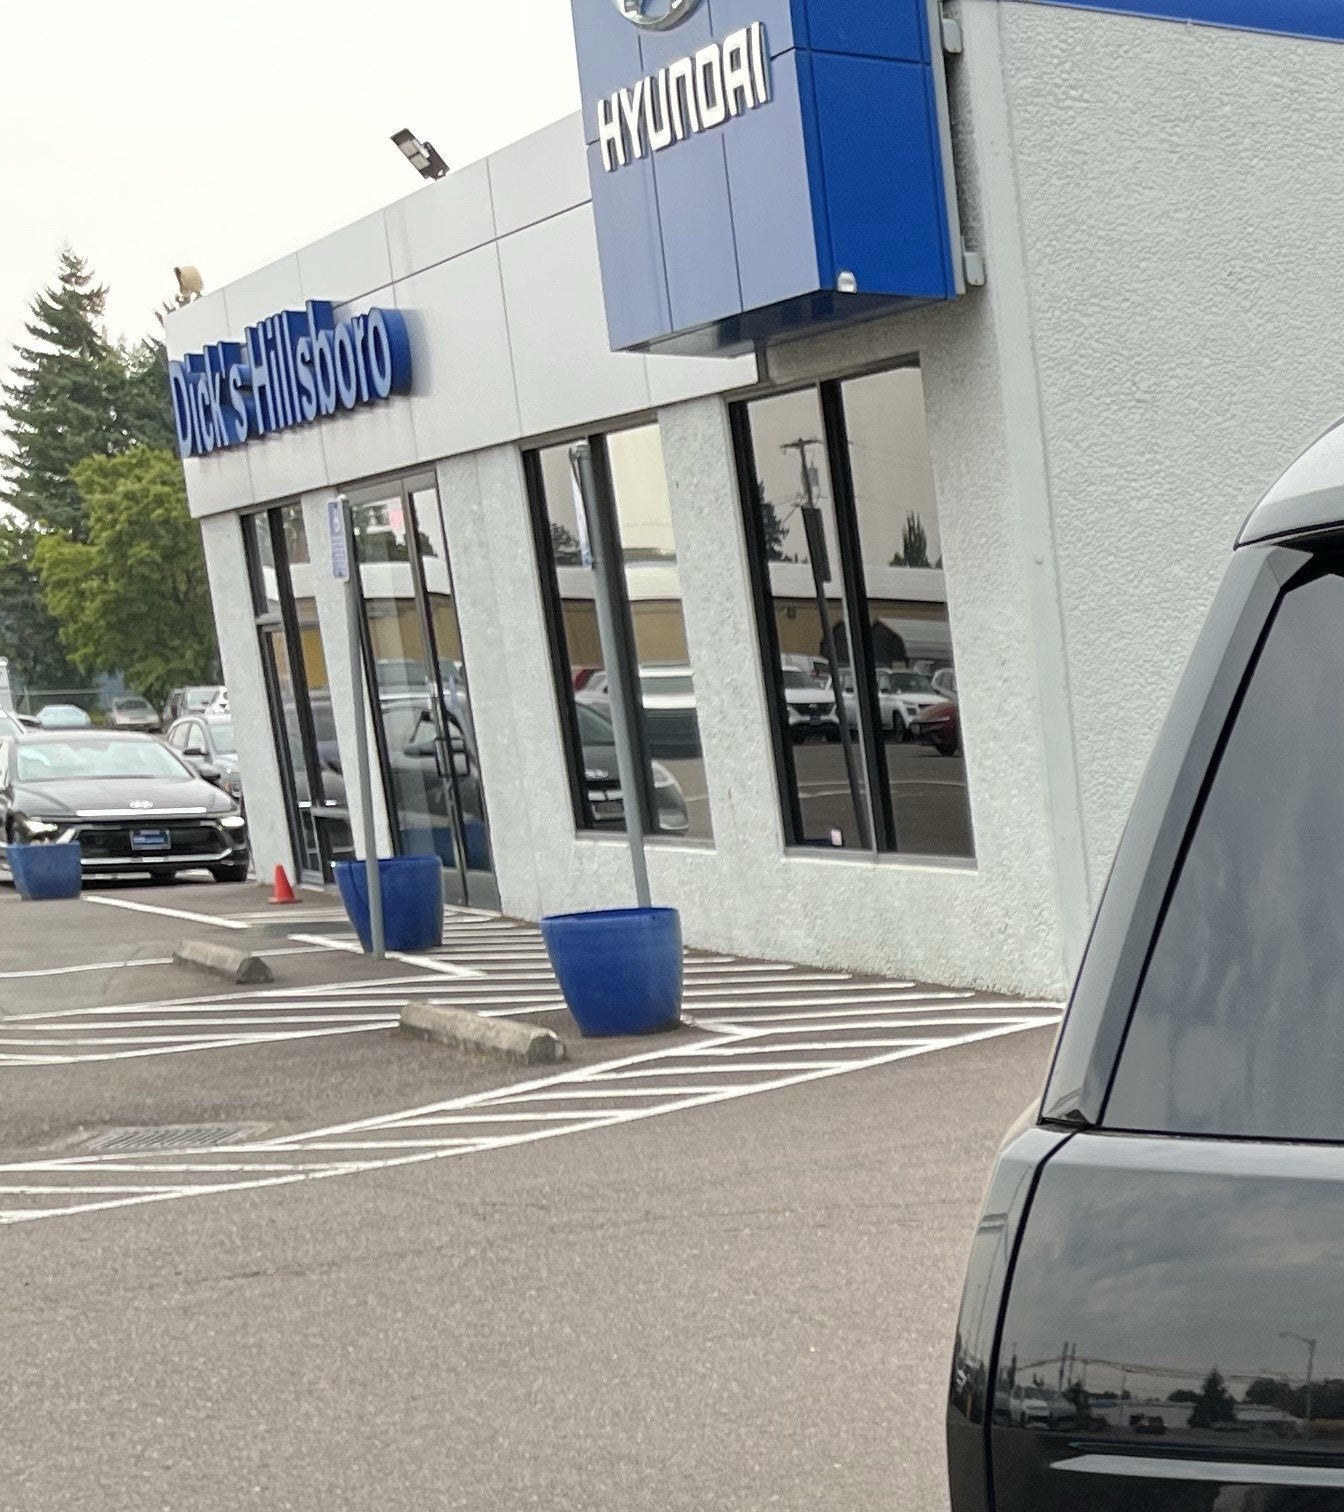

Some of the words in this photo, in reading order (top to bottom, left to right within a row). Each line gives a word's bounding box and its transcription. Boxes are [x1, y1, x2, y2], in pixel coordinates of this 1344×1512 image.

[598, 21, 767, 173] HYUNDAI
[168, 340, 249, 459] Dick's
[245, 300, 396, 436] Hillsboro
